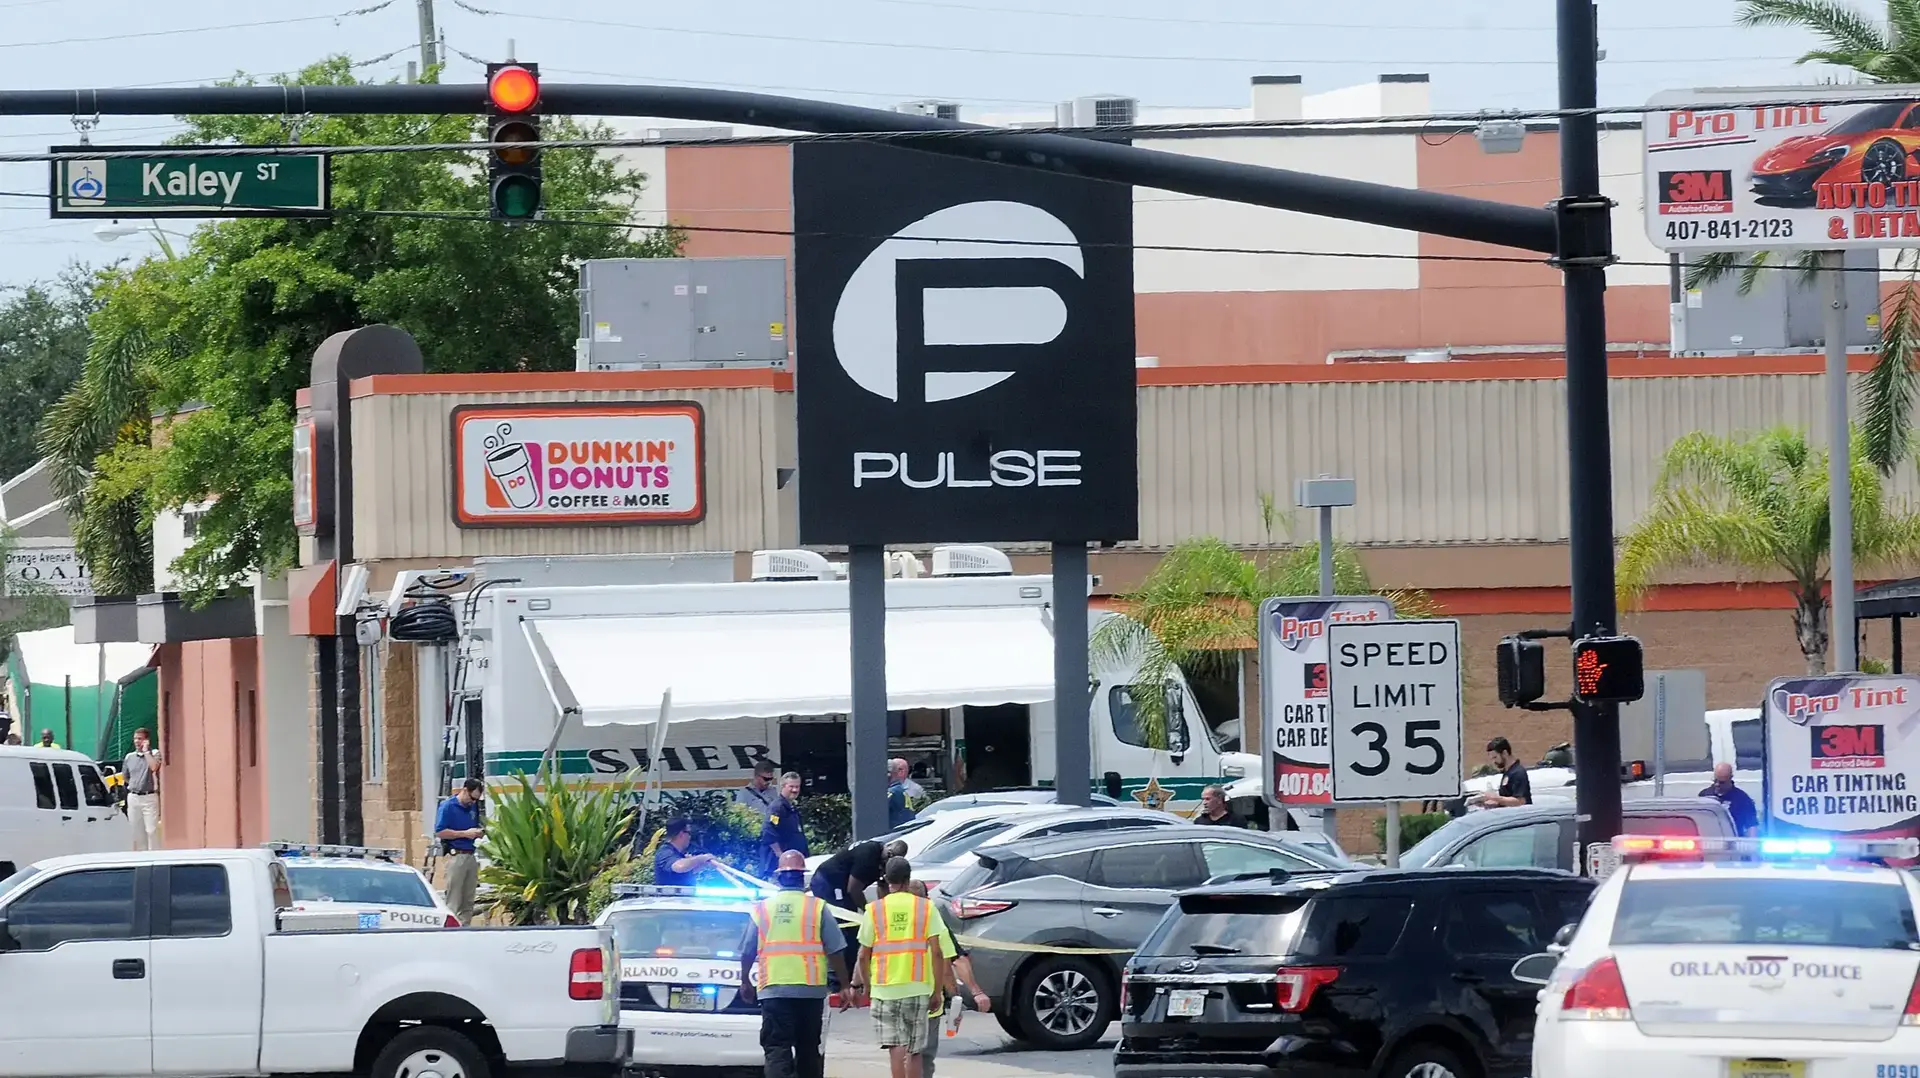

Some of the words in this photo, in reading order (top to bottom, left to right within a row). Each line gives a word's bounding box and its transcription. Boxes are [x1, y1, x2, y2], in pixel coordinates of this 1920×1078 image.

[1668, 109, 1735, 138] Pro
[1754, 104, 1828, 131] Tint
[143, 163, 242, 204] Kaley
[257, 163, 280, 180] ST
[1668, 172, 1724, 202] 3M
[1815, 182, 1887, 210] AUTO
[1891, 181, 1920, 208] TI
[1666, 219, 1793, 240] 407-841-2123
[1828, 215, 1849, 239] &
[1853, 209, 1920, 239] DETA
[548, 441, 675, 464] DUNKIN'
[548, 466, 670, 490] DONUTS
[853, 450, 1082, 488] PULSE
[548, 496, 609, 508] COFFEE
[612, 496, 622, 506] &
[624, 494, 670, 507] MORE
[40, 552, 71, 562] Avenue
[1282, 619, 1323, 640] Pro
[1340, 642, 1448, 667] SPEED
[1311, 665, 1328, 688] 3
[1353, 683, 1436, 709] LIMIT
[1787, 695, 1839, 716] Pro
[1849, 686, 1908, 709] Tint
[1284, 704, 1314, 723] CAR
[1277, 727, 1306, 748] CAR
[1310, 727, 1328, 746] DE
[1350, 720, 1446, 776] 35
[1821, 726, 1877, 757] 3M
[1792, 775, 1828, 793] CAR
[1834, 773, 1906, 792] TINTING
[1782, 796, 1818, 815] CAR
[1824, 794, 1917, 815] DETAILING
[390, 911, 441, 926] POLICE
[622, 966, 678, 978] RLANDO
[1670, 961, 1781, 977] ORLANDO
[1792, 962, 1862, 980] POLICE
